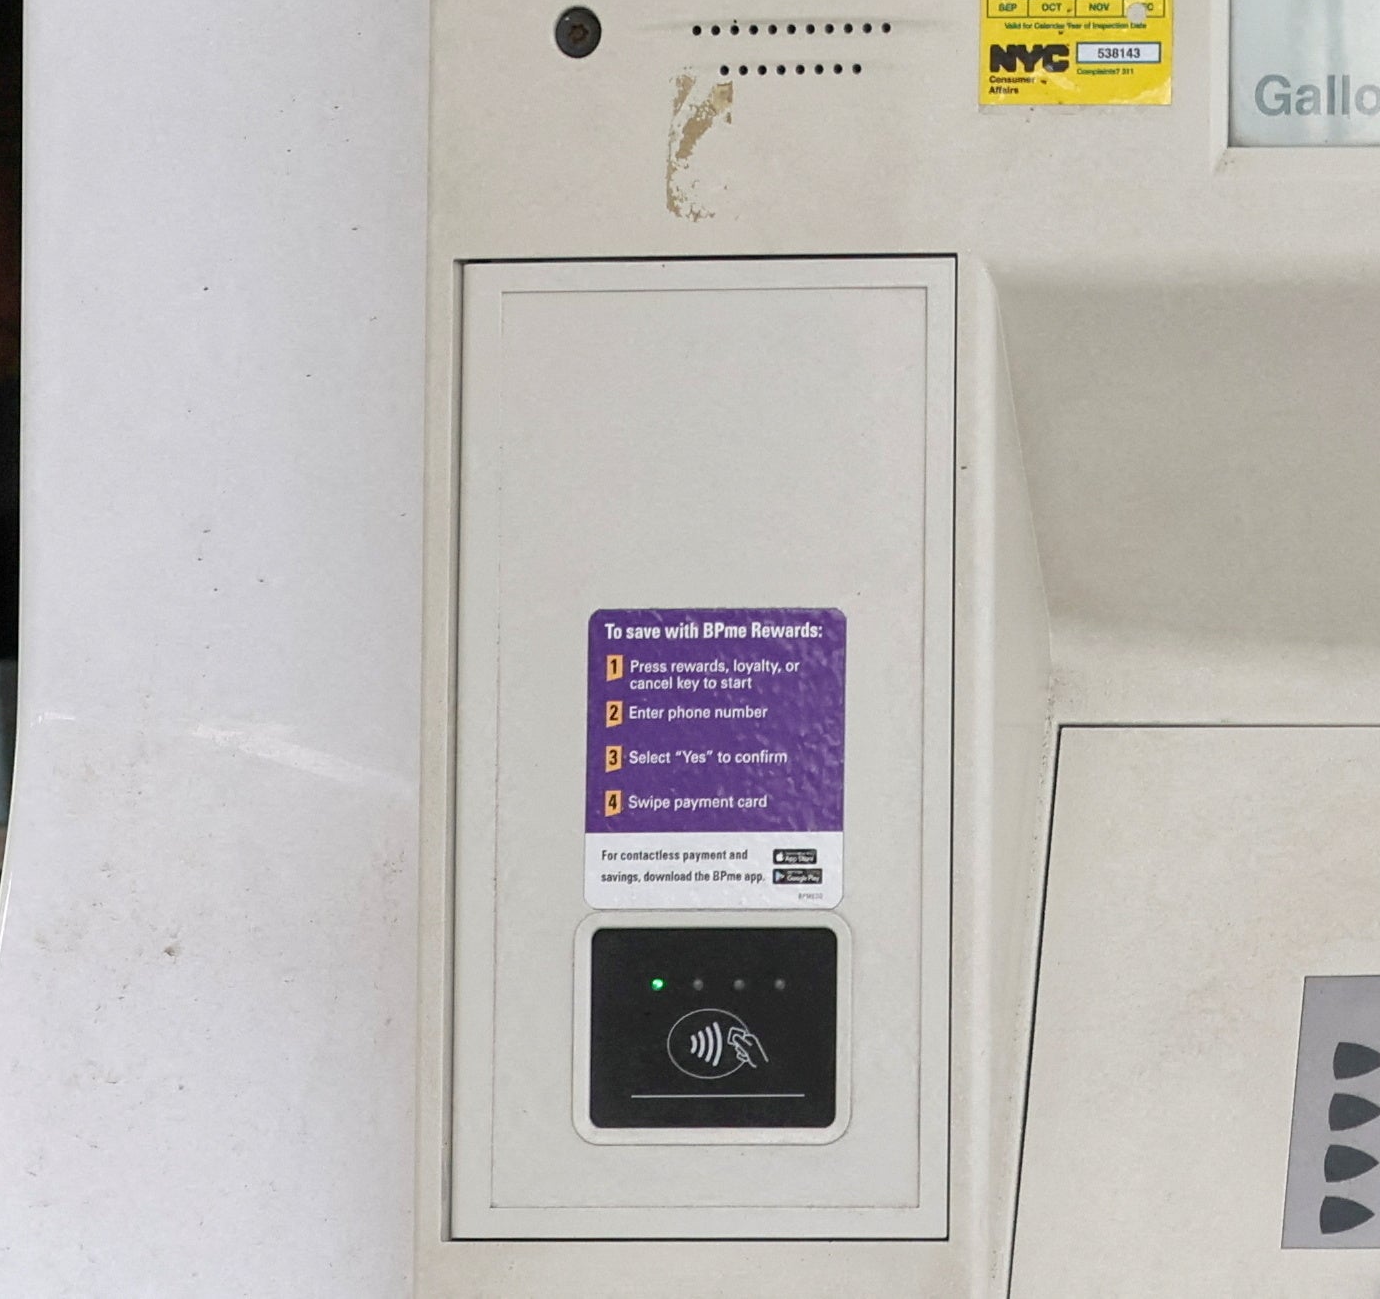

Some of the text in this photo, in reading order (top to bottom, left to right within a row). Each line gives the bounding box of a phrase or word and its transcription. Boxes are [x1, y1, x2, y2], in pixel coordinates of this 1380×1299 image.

[999, 3, 1017, 12] SEP
[1042, 3, 1062, 12] OCT
[1089, 3, 1109, 12] NOV
[990, 44, 1070, 73] NYC
[1098, 48, 1141, 59] 538143
[989, 76, 1035, 84] Consumer
[989, 86, 1019, 94] Affairs
[605, 621, 822, 639] To save with BPme Rewards:
[610, 659, 800, 675] 1 Press rewards, loyalty, or
[630, 676, 752, 691] cancel key to start
[609, 705, 768, 721] 2 Enter phone number
[609, 750, 788, 765] 3 Select “Yes” to confirm
[608, 794, 767, 811] 4 Swipe payment card
[602, 849, 748, 863] For contactless payment and
[601, 870, 765, 884] savings, download the BPme app.
